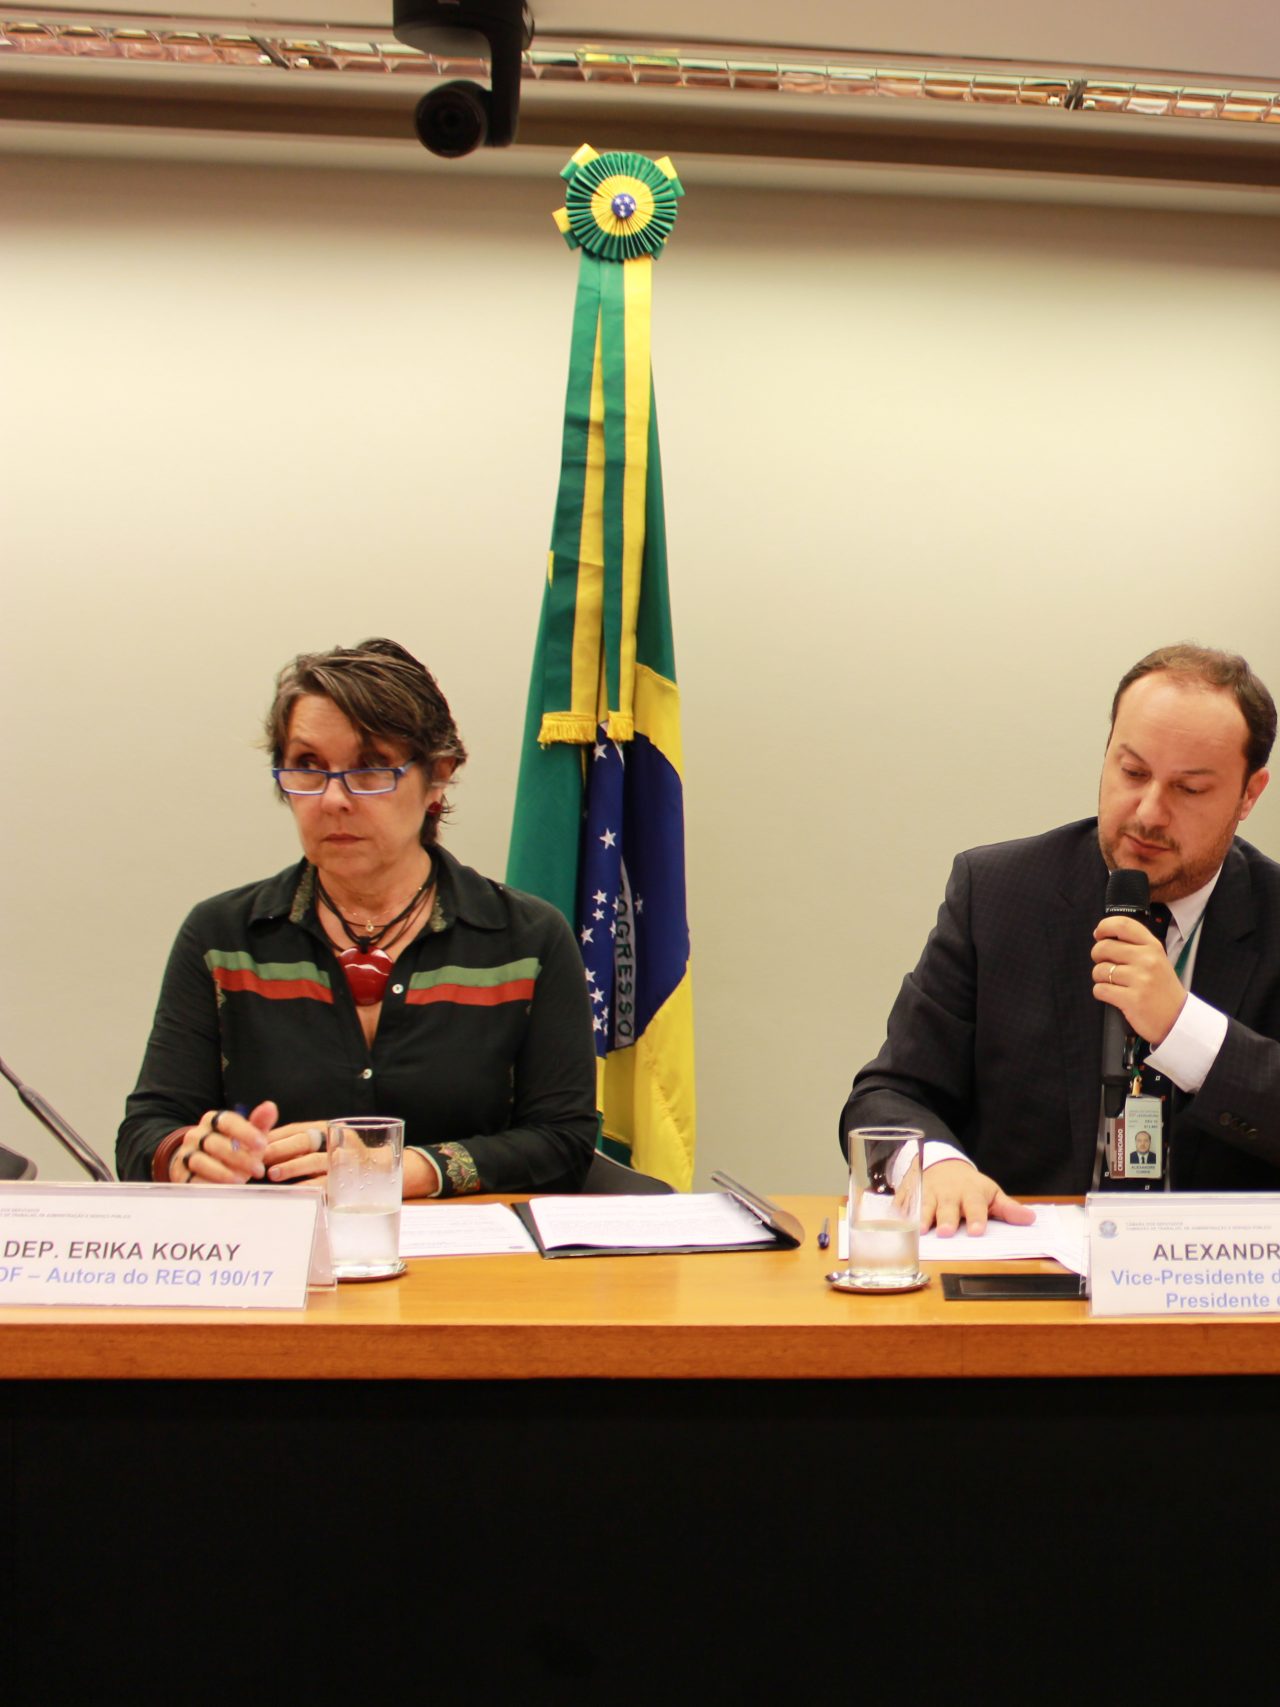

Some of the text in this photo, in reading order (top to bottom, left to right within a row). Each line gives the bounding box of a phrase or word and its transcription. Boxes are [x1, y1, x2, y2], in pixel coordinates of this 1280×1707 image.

[3, 1240, 241, 1262] DEP. ERIKA KOKAY
[46, 1267, 116, 1285] Autora
[123, 1268, 148, 1285] do
[155, 1269, 201, 1287] REQ
[209, 1269, 274, 1287] 190/17
[1111, 1268, 1264, 1286] Vice-Presidente
[1166, 1292, 1270, 1309] Presidente
